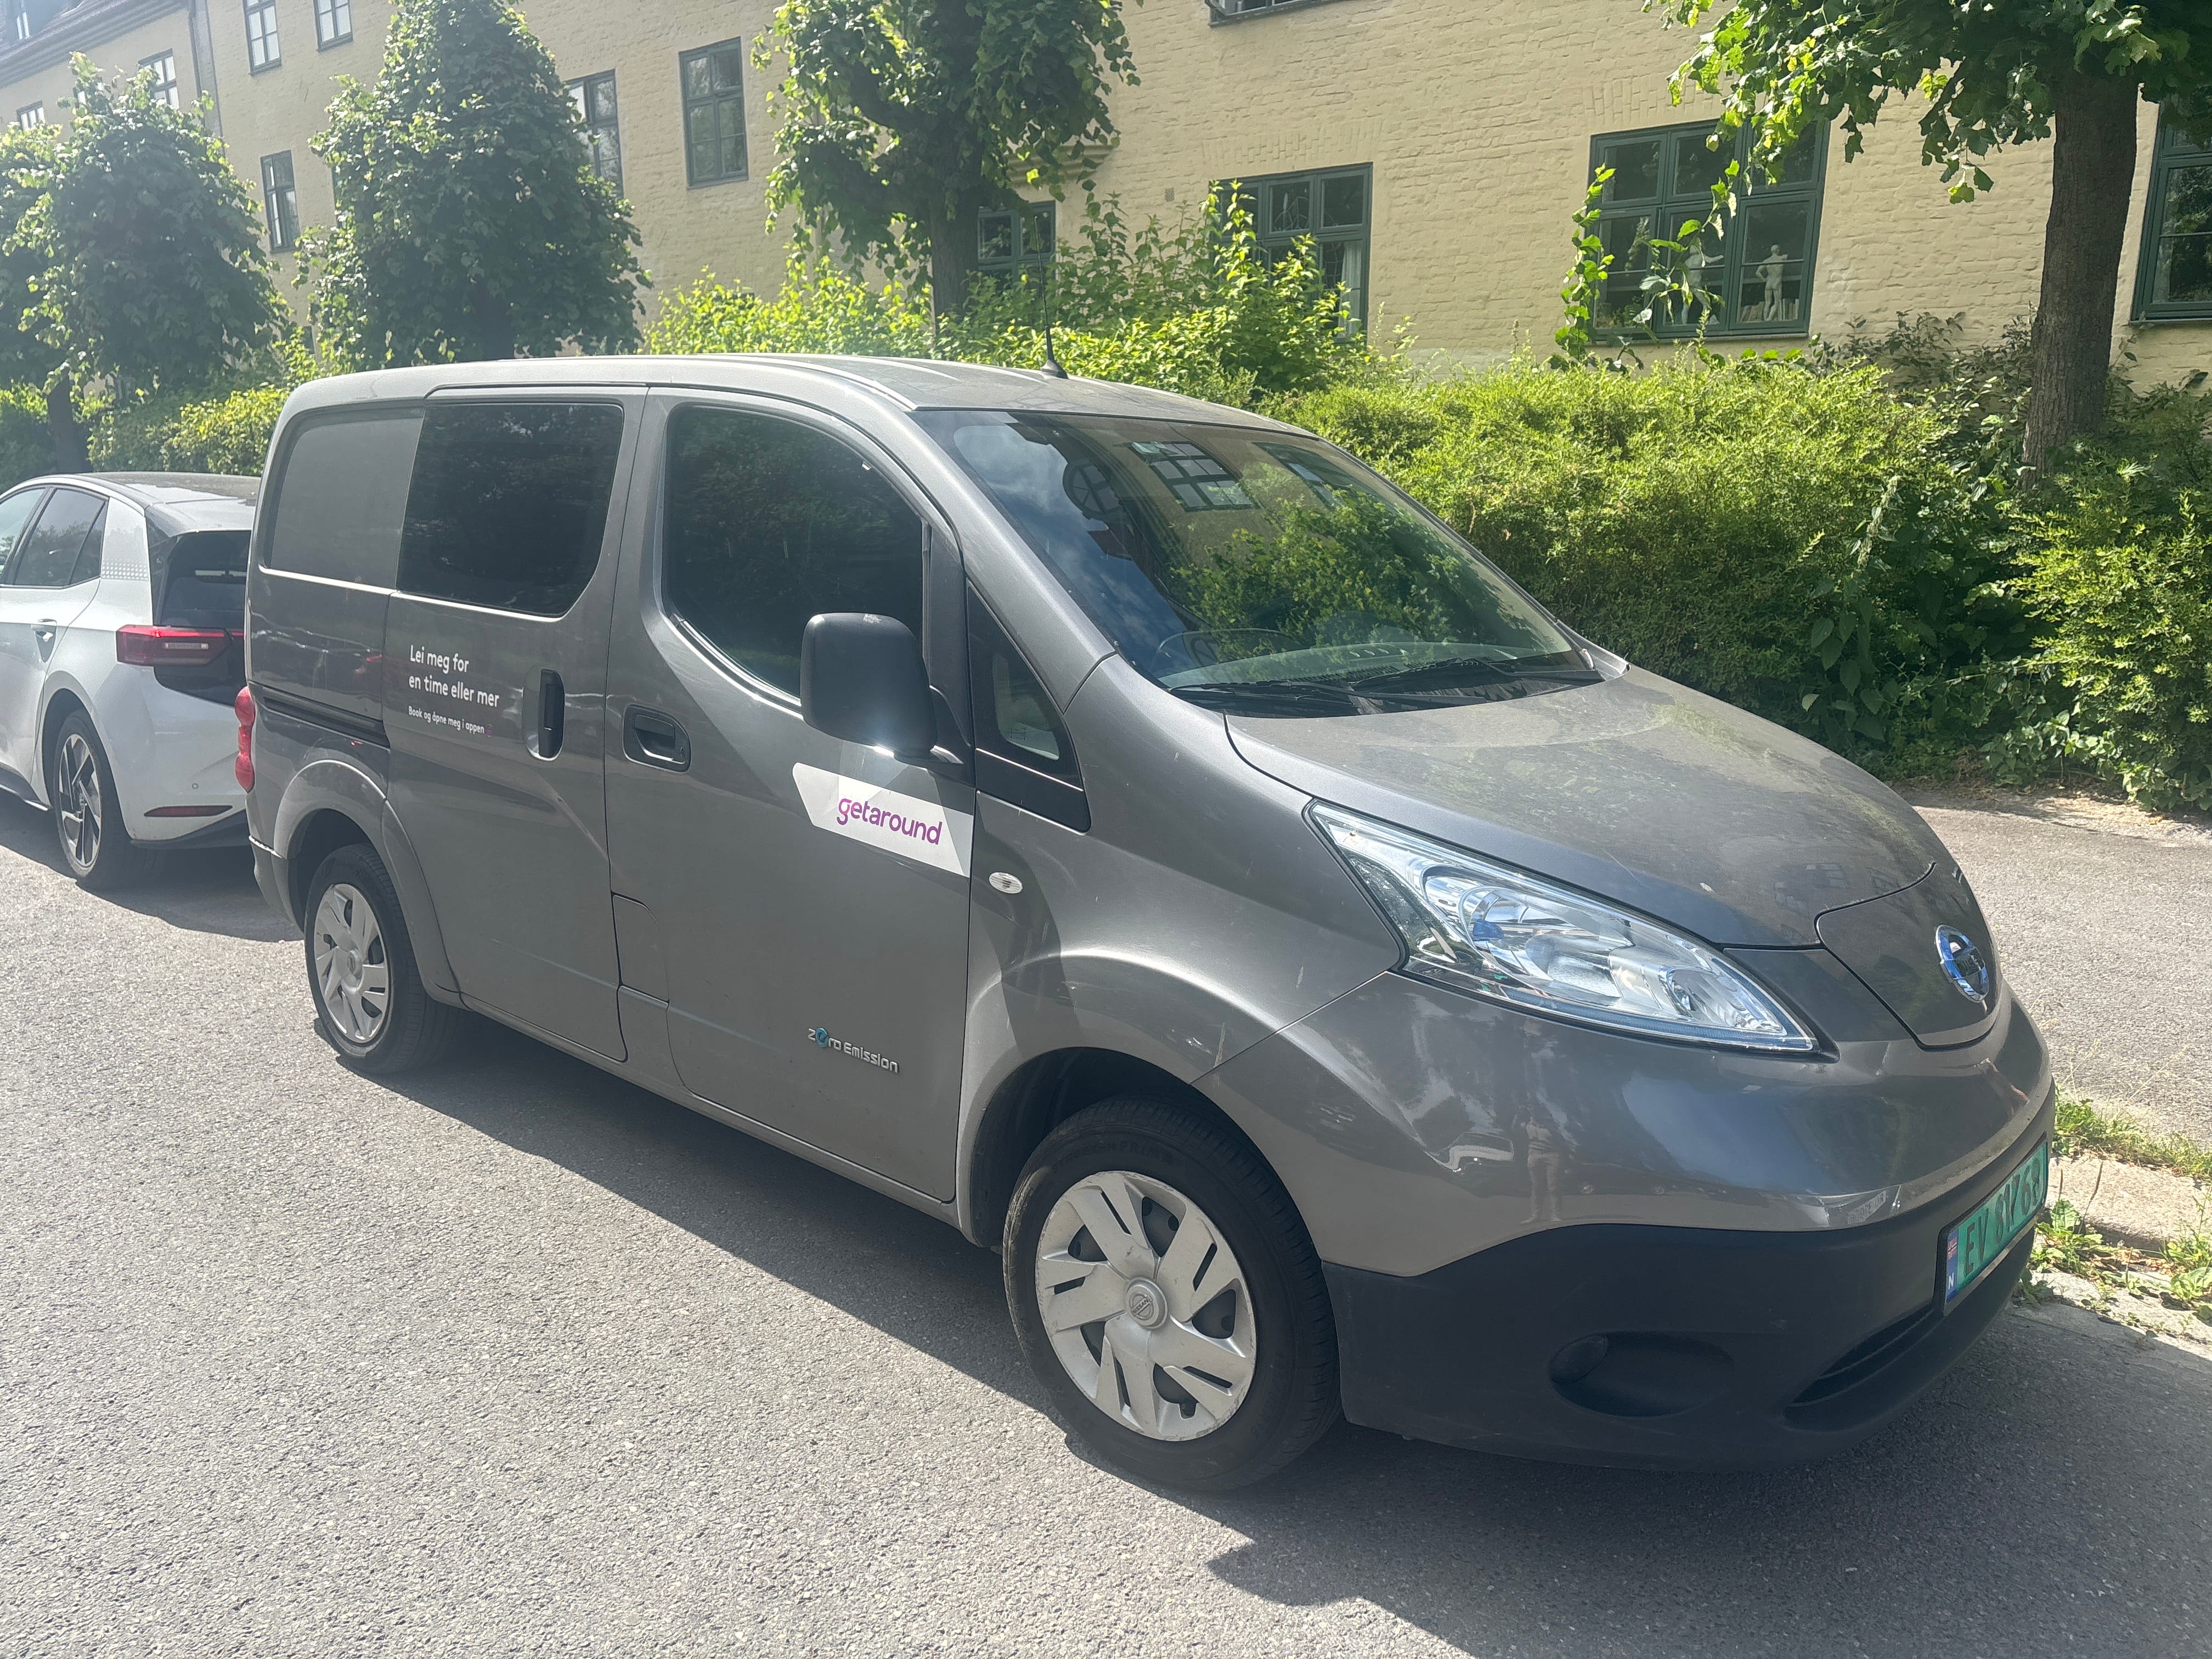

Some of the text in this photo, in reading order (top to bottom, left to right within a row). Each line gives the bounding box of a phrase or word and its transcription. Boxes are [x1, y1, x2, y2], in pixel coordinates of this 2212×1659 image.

[410, 645, 470, 674] Lei meg for
[409, 675, 499, 708] en time eller mer
[408, 706, 485, 735] Book og åpne meg i appen
[836, 798, 943, 845] getaround
[843, 1041, 899, 1074] Emission
[1965, 1207, 1989, 1278] EV
[1948, 1272, 1955, 1290] N
